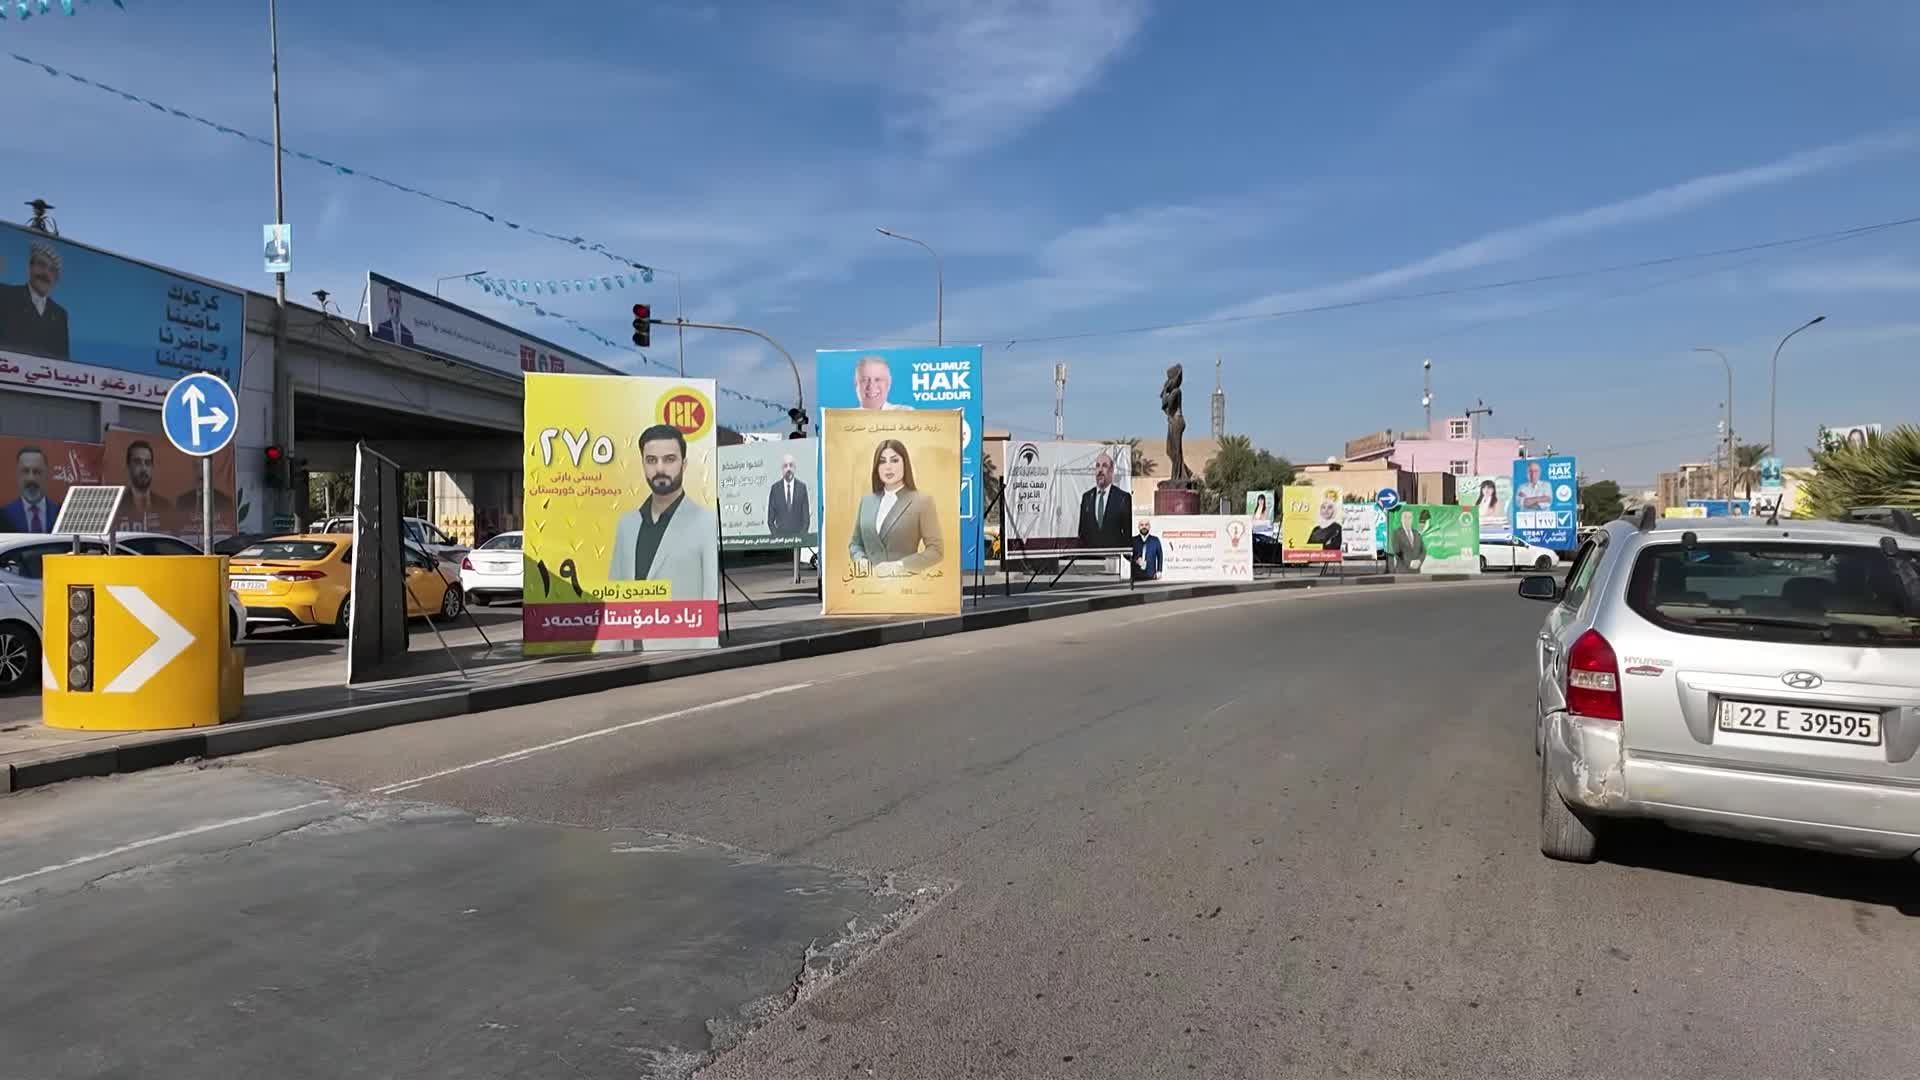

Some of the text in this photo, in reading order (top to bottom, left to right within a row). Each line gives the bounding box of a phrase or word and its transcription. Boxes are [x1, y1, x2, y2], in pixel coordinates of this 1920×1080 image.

[25, 365, 95, 388] البياتي
[912, 361, 971, 372] YOLUMUZ
[912, 371, 971, 391] HAK
[913, 391, 971, 402] YOLUDUR
[539, 428, 614, 467] ٢٧٥
[1548, 466, 1571, 475] HAK
[537, 558, 583, 598] ١٩
[1740, 707, 1871, 738] 22 E 39595
